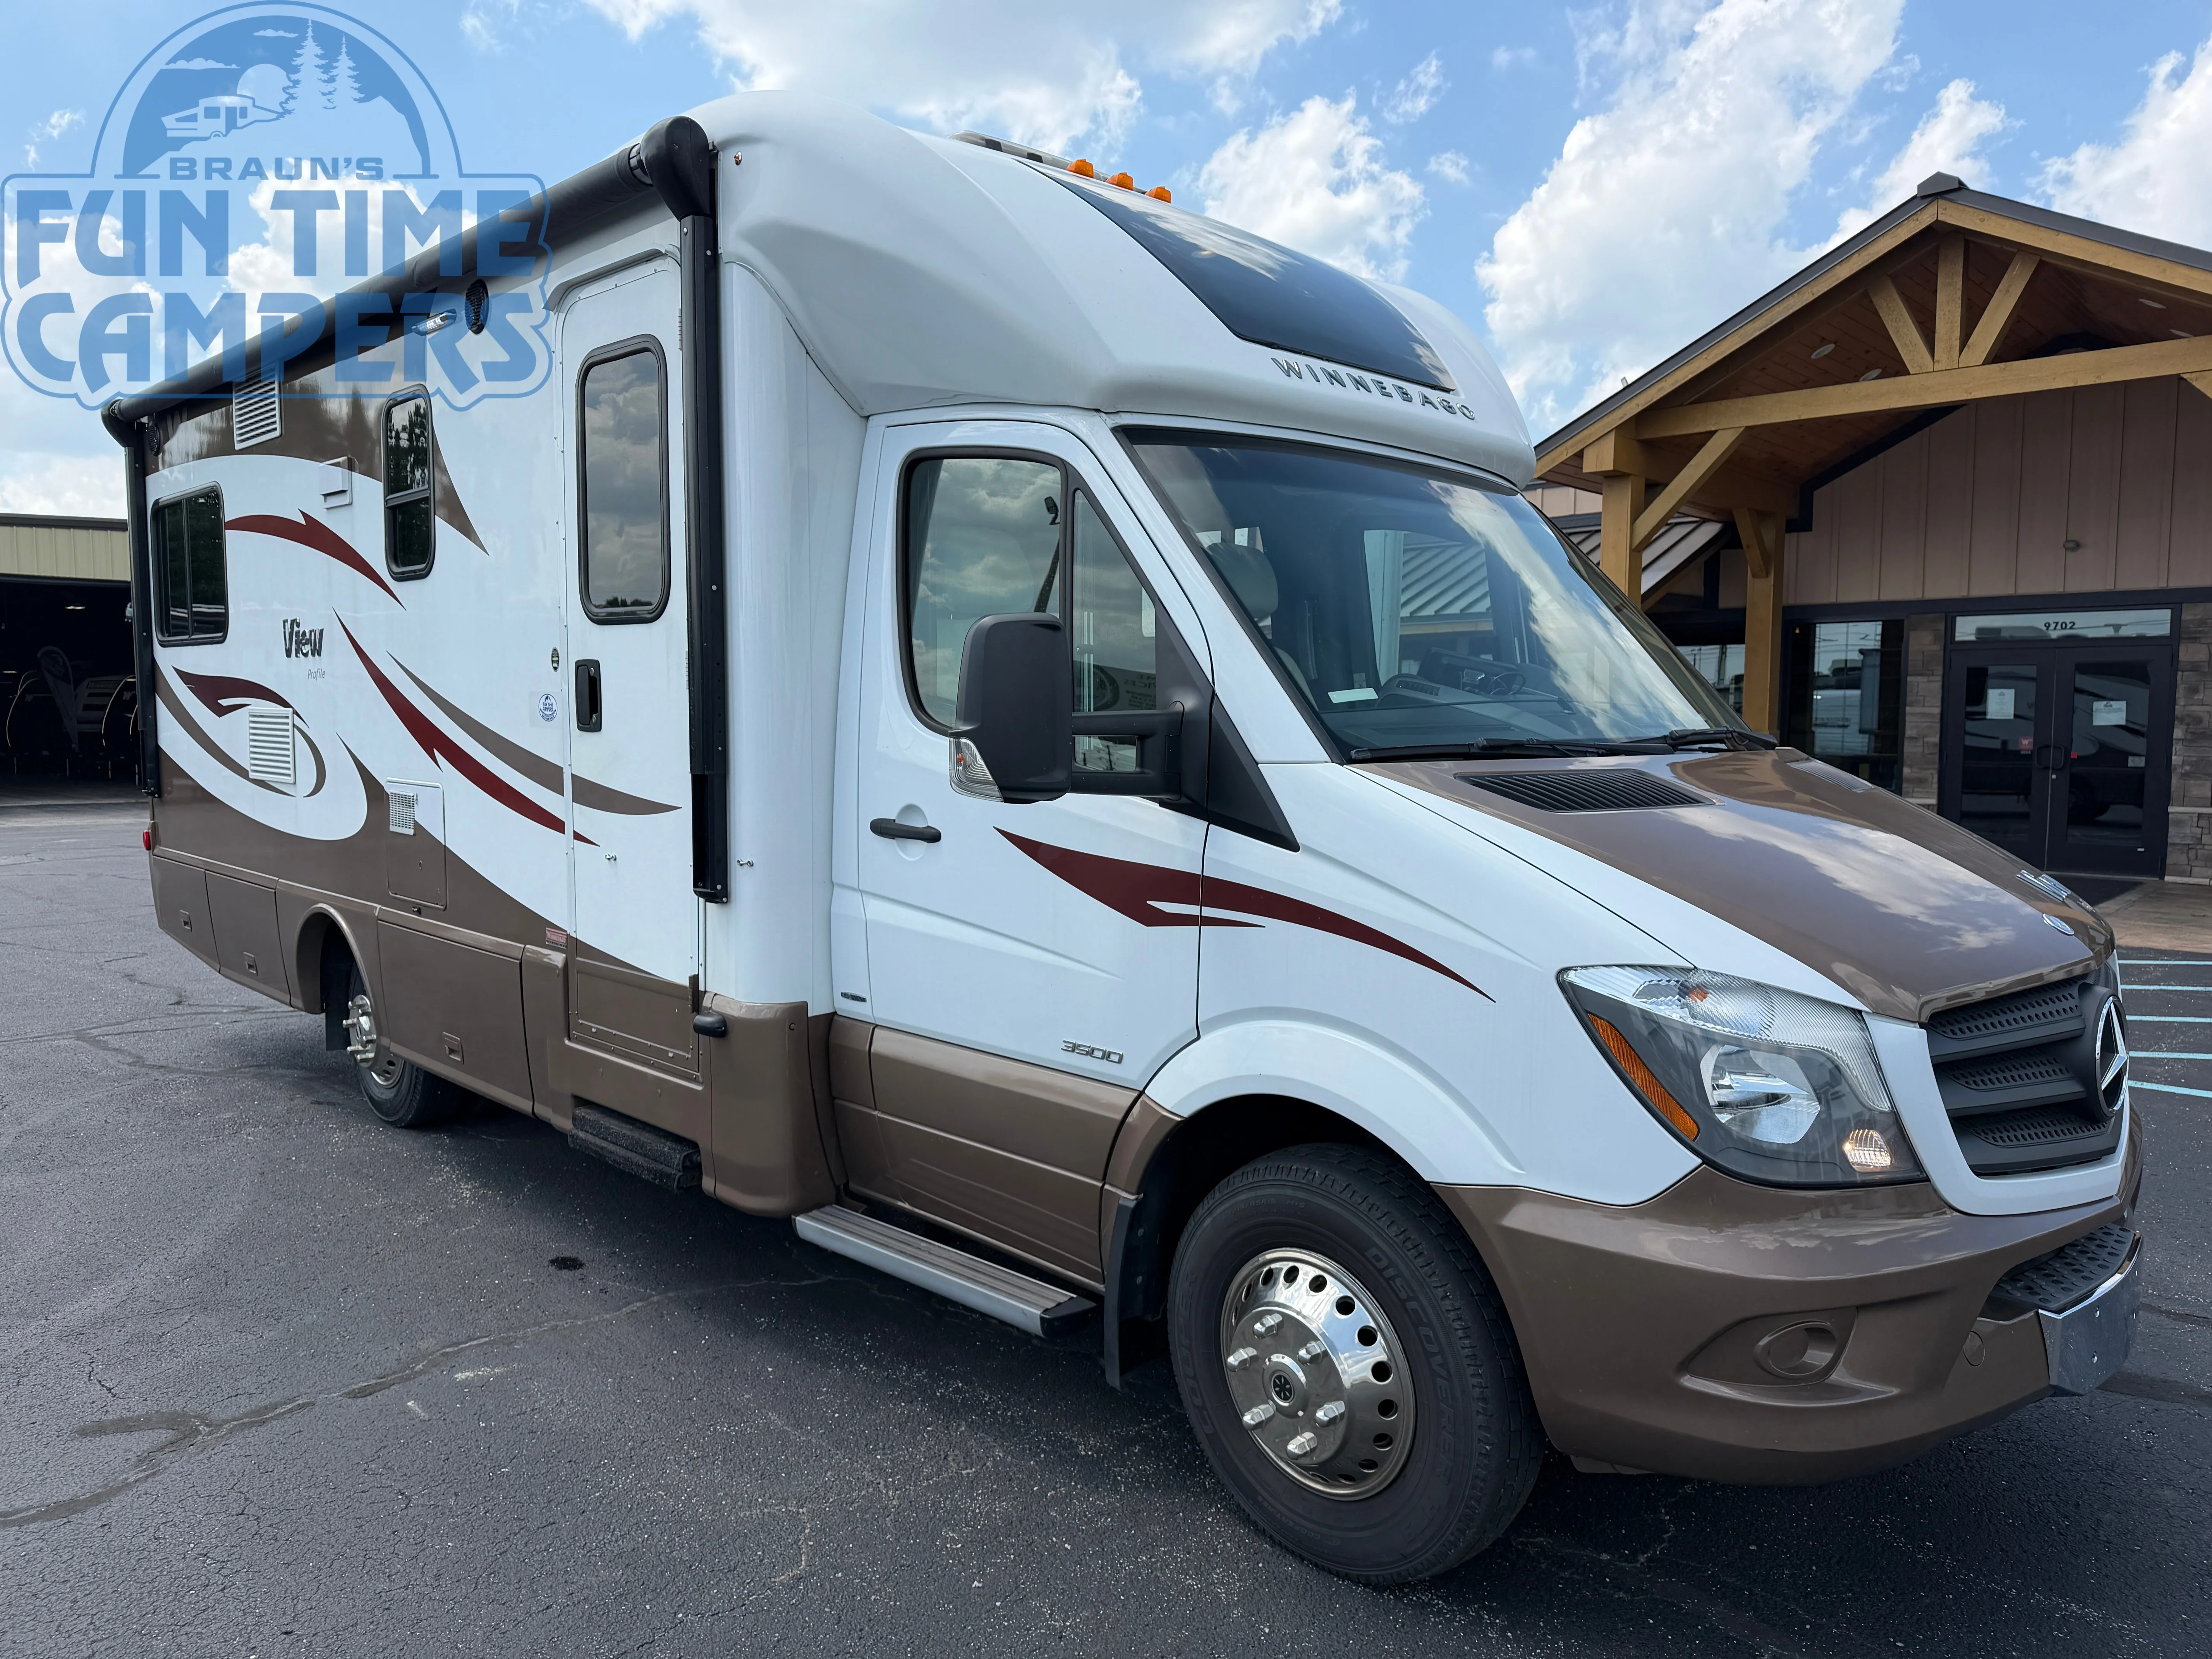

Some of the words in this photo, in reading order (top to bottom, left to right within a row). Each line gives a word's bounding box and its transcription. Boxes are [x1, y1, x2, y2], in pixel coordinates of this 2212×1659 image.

[1271, 357, 1476, 420] WINNEBAGO
[282, 616, 324, 658] View
[2044, 621, 2076, 631] 9702
[307, 668, 325, 681] Profile
[1061, 1039, 1124, 1064] 3500
[1364, 1246, 1455, 1486] DISCOVERER
